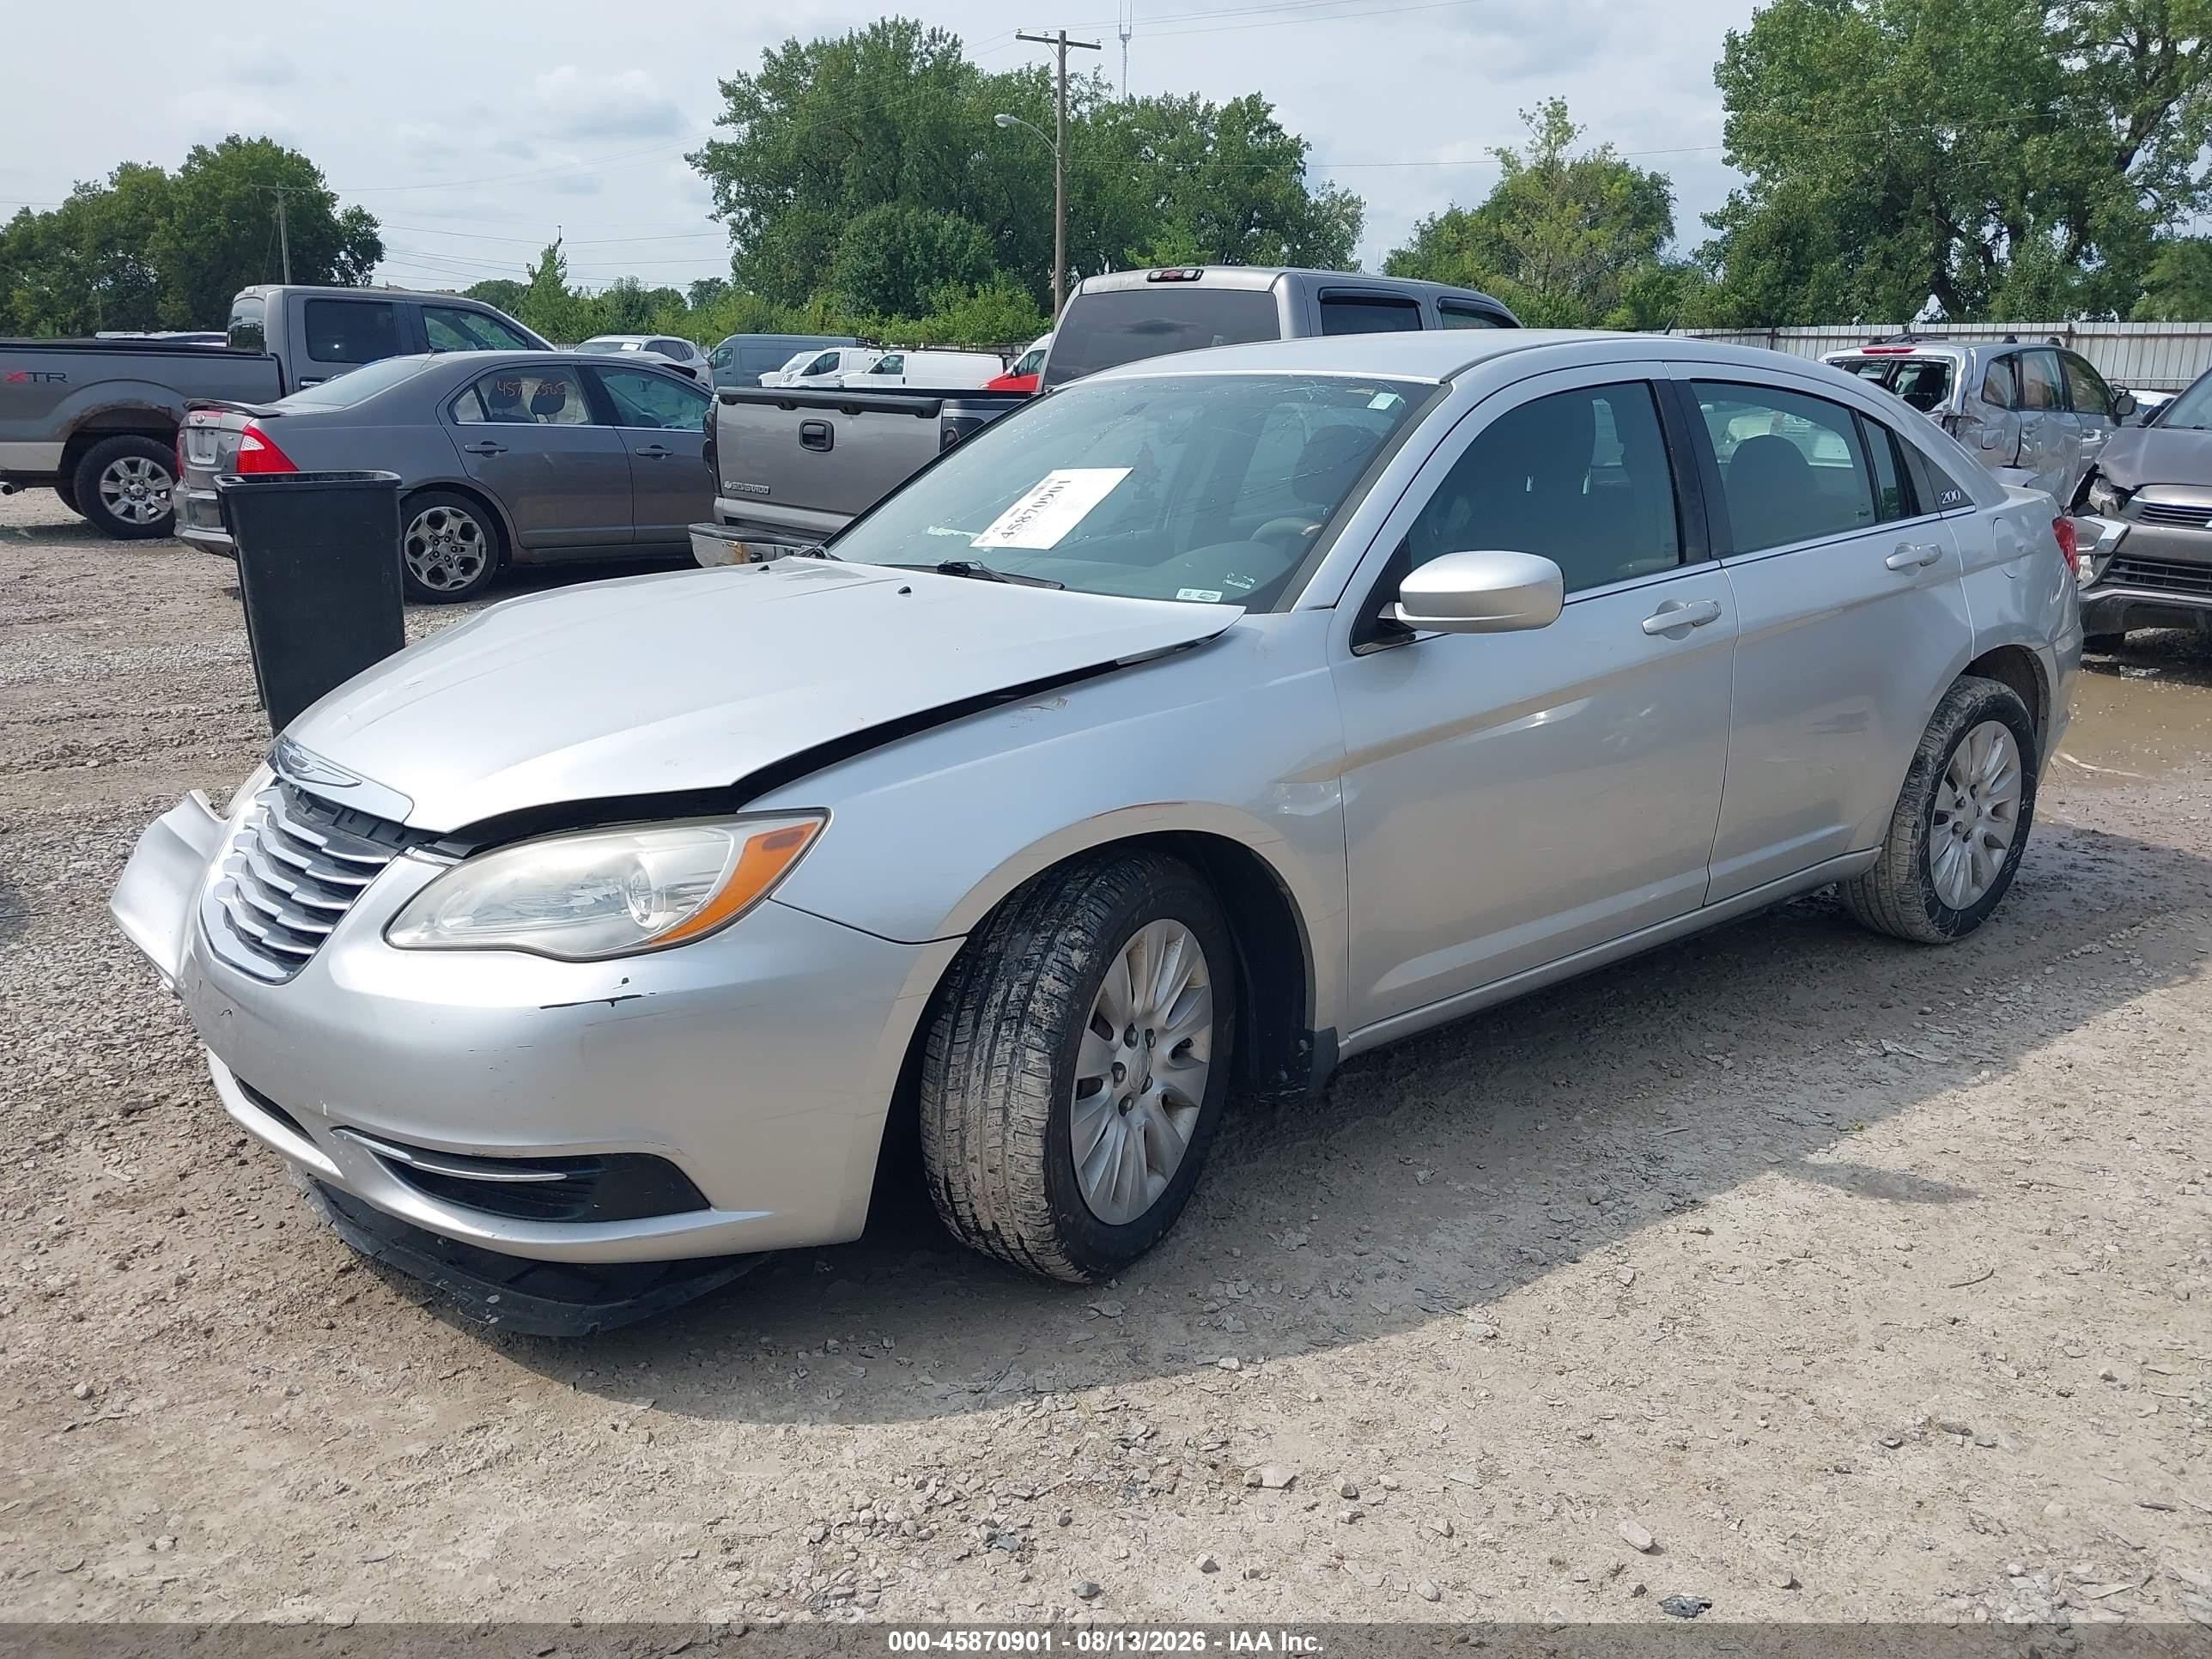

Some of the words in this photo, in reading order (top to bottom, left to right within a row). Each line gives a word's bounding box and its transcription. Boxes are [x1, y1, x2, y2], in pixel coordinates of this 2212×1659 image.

[6, 371, 69, 383] XTR
[1941, 489, 1961, 504] 200
[1001, 480, 1072, 539] 45870901
